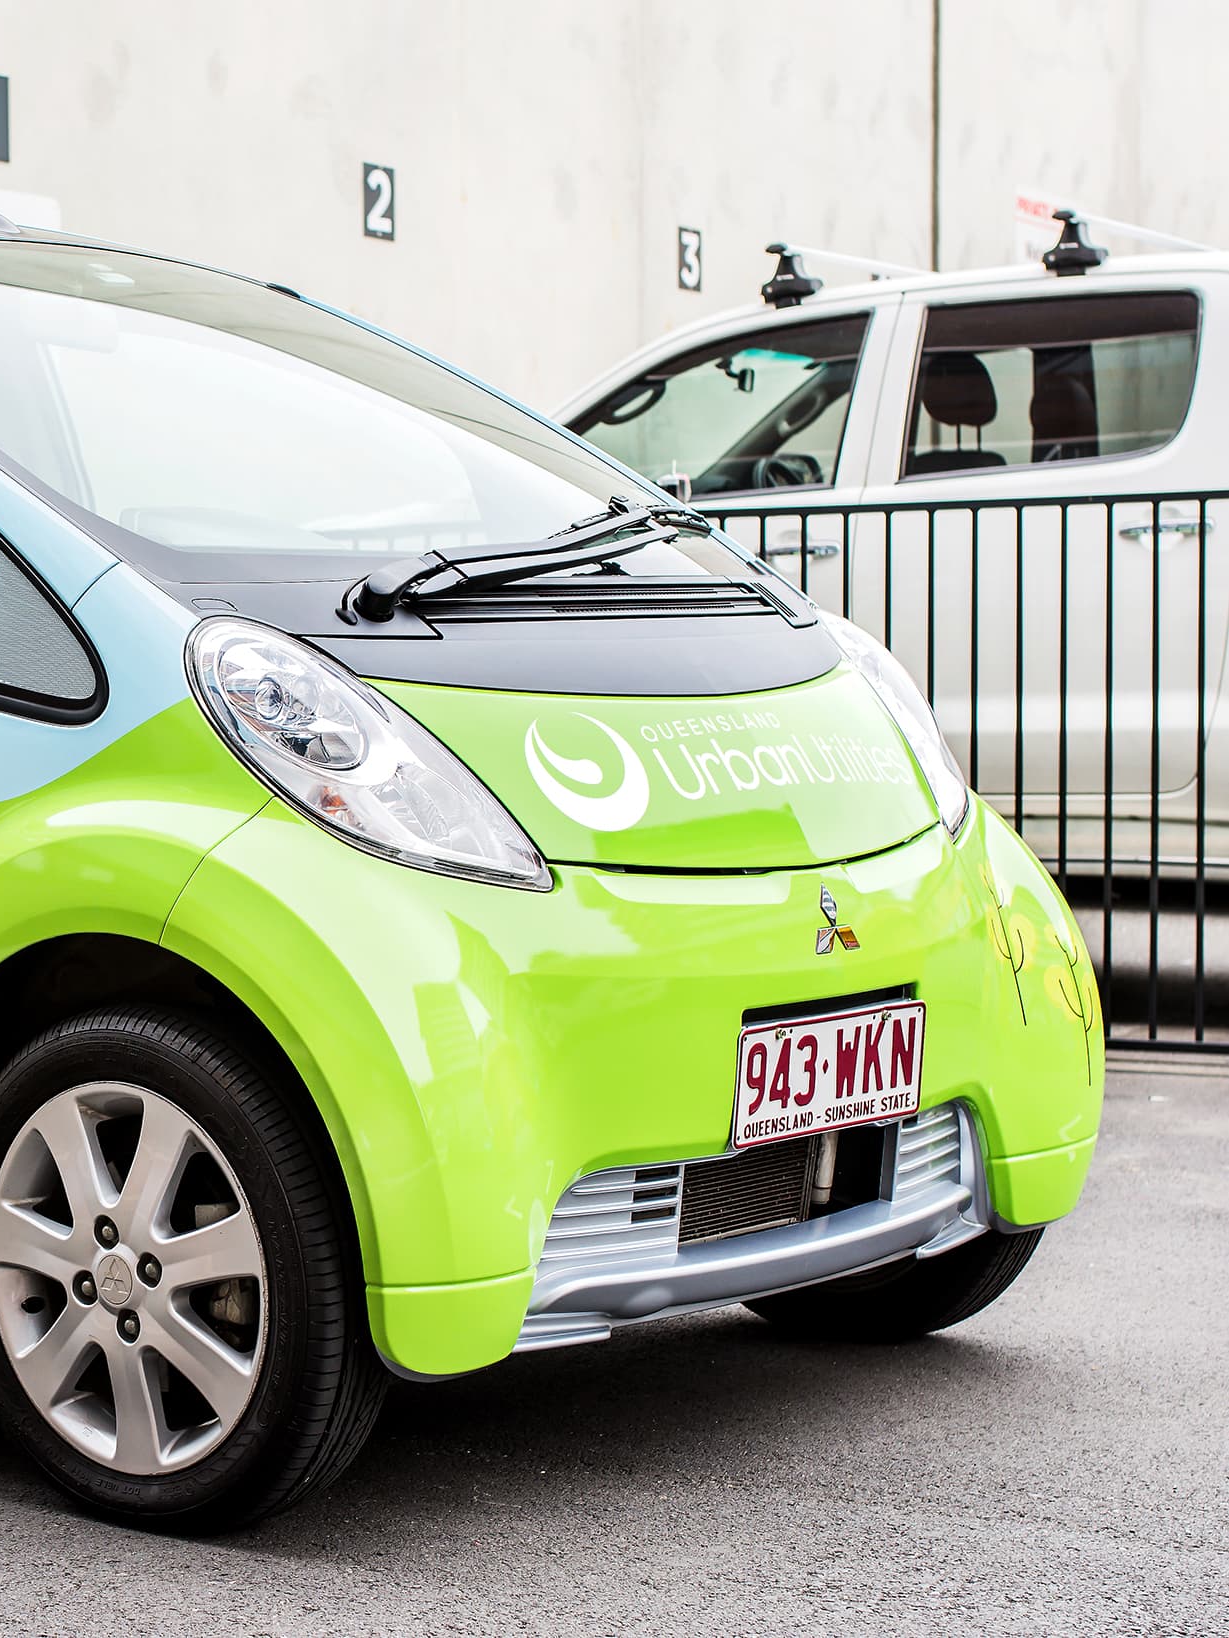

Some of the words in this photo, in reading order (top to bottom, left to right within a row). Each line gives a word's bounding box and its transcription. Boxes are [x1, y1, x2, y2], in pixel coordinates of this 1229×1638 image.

[367, 168, 392, 233] 2
[680, 232, 699, 288] 3
[640, 711, 782, 744] QUEENSLAND
[743, 1110, 814, 1140] QUEENSLAND
[824, 1099, 876, 1123] SUNSHINE
[880, 1092, 911, 1112] STATE
